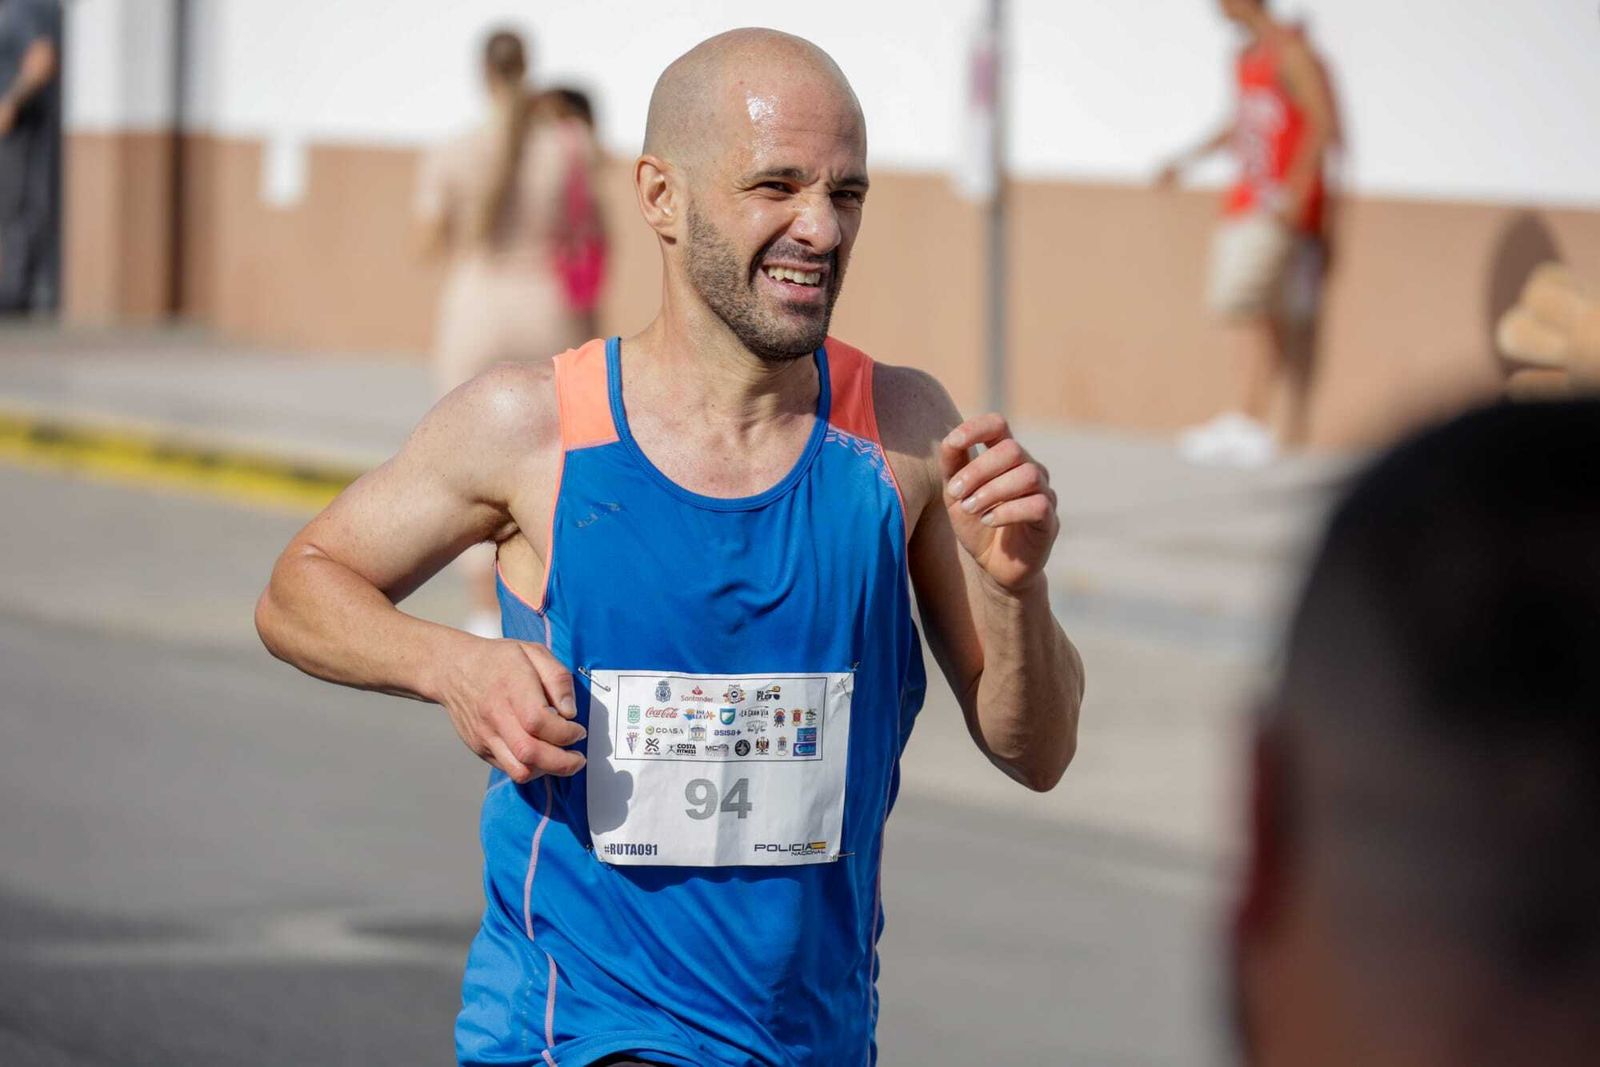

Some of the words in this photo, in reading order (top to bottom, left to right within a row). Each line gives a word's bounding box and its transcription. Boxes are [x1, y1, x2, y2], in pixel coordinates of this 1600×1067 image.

[681, 695, 713, 703] Santander
[684, 777, 753, 820] 94
[604, 843, 658, 856] #RUTA091
